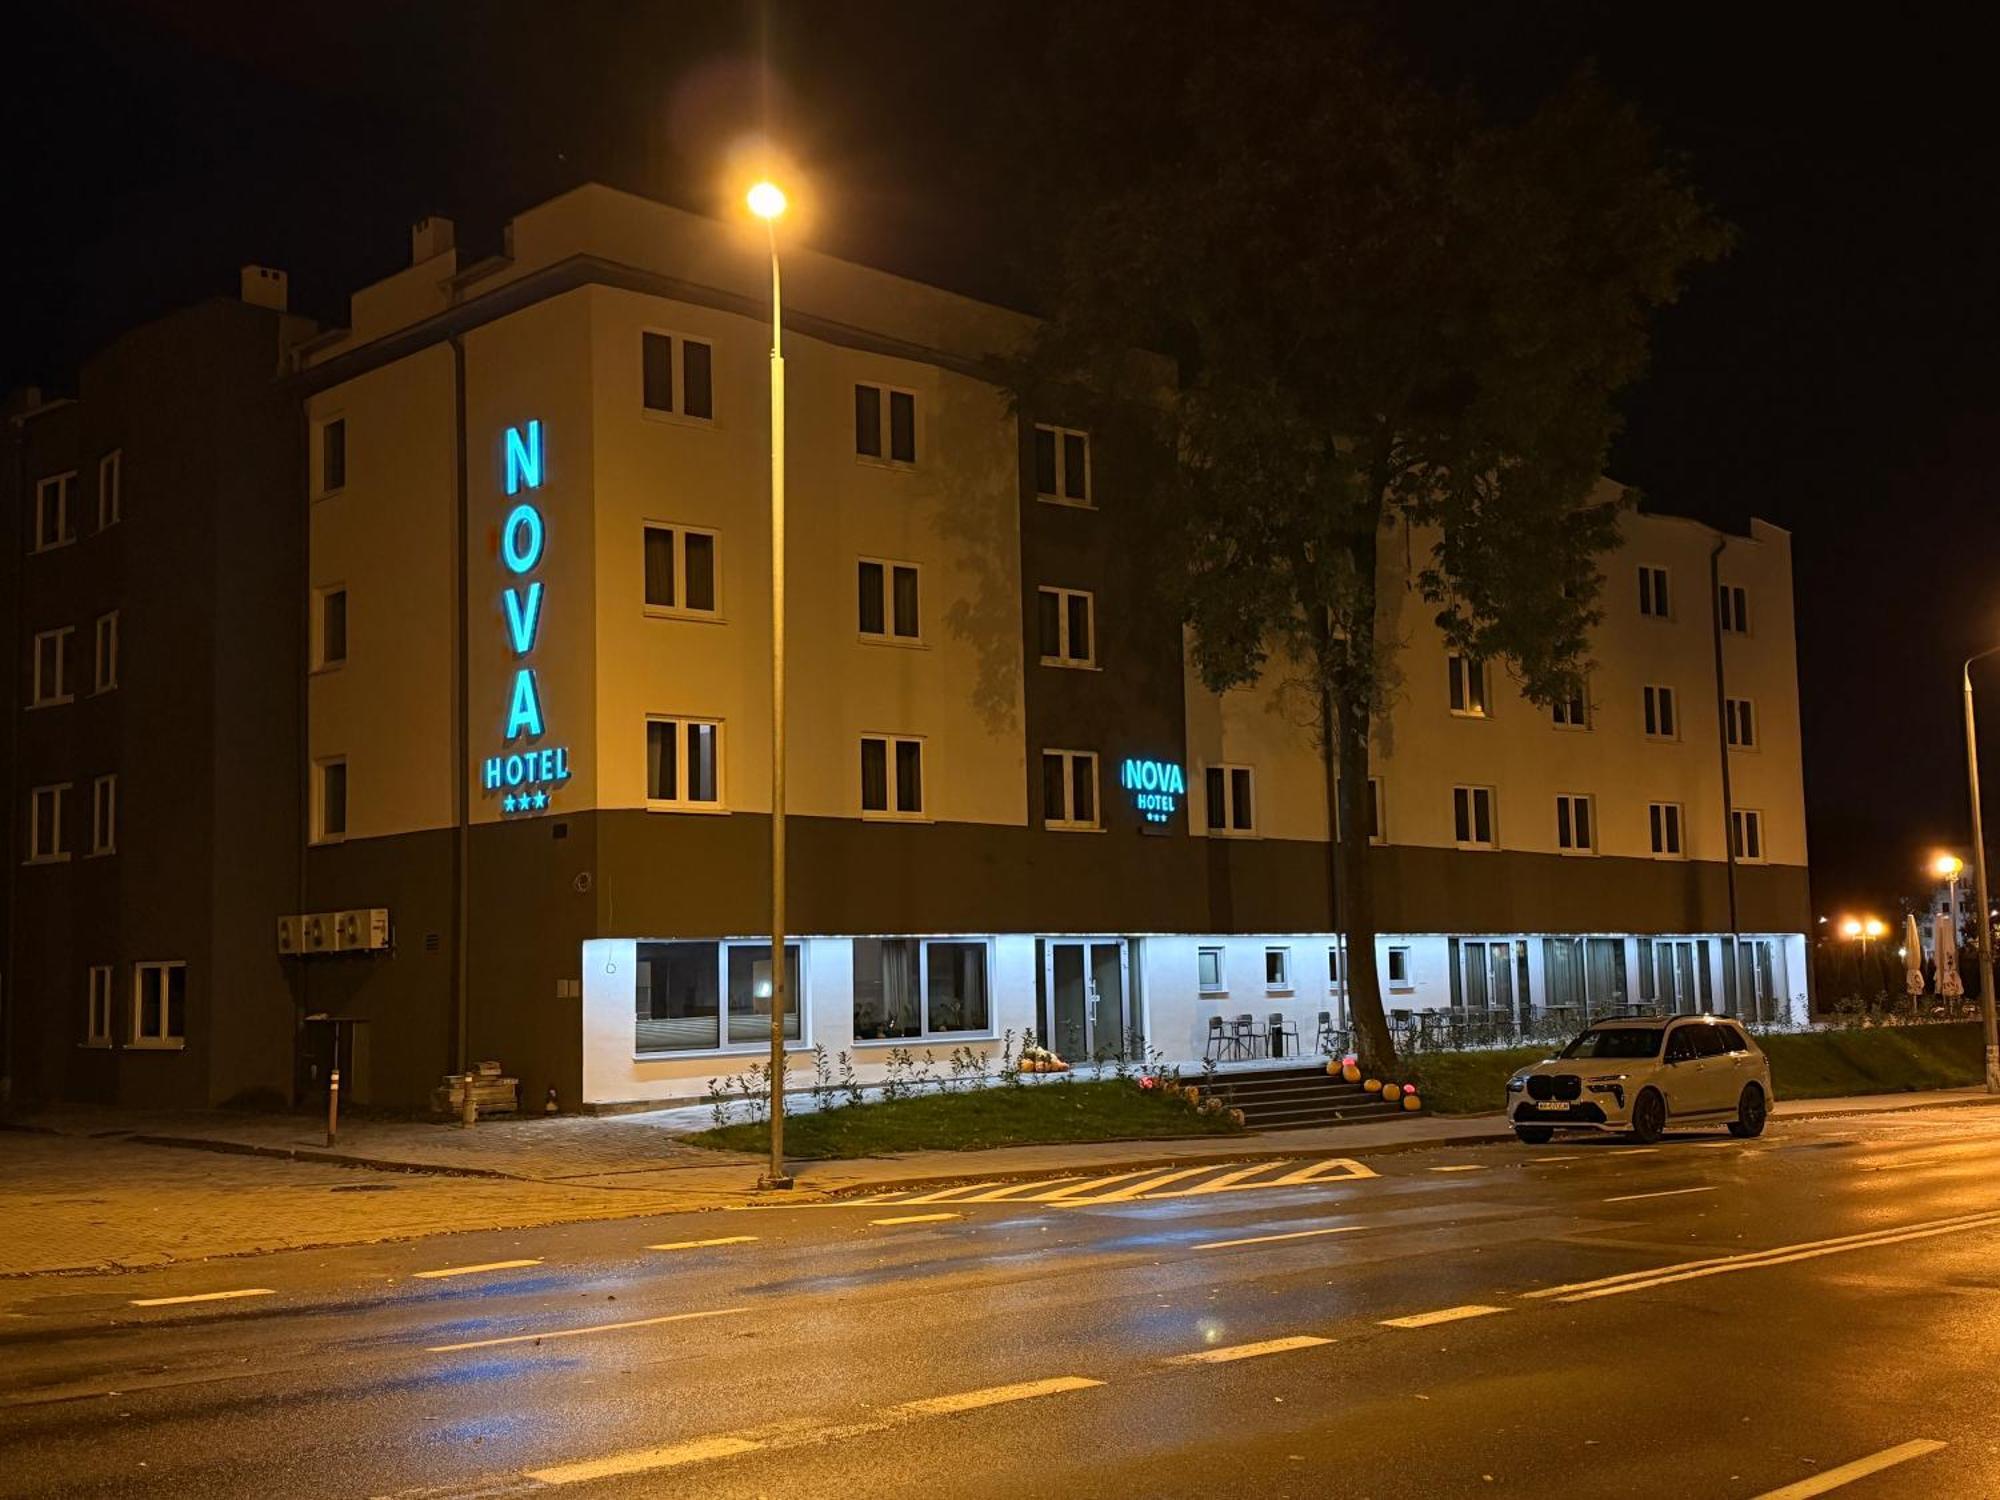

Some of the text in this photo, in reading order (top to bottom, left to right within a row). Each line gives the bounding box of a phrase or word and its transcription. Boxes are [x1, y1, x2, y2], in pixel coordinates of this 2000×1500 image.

[502, 420, 545, 740] NOVA
[485, 748, 571, 789] HOTEL
[1126, 759, 1184, 794] NOVA
[1137, 794, 1175, 812] HOTEL
